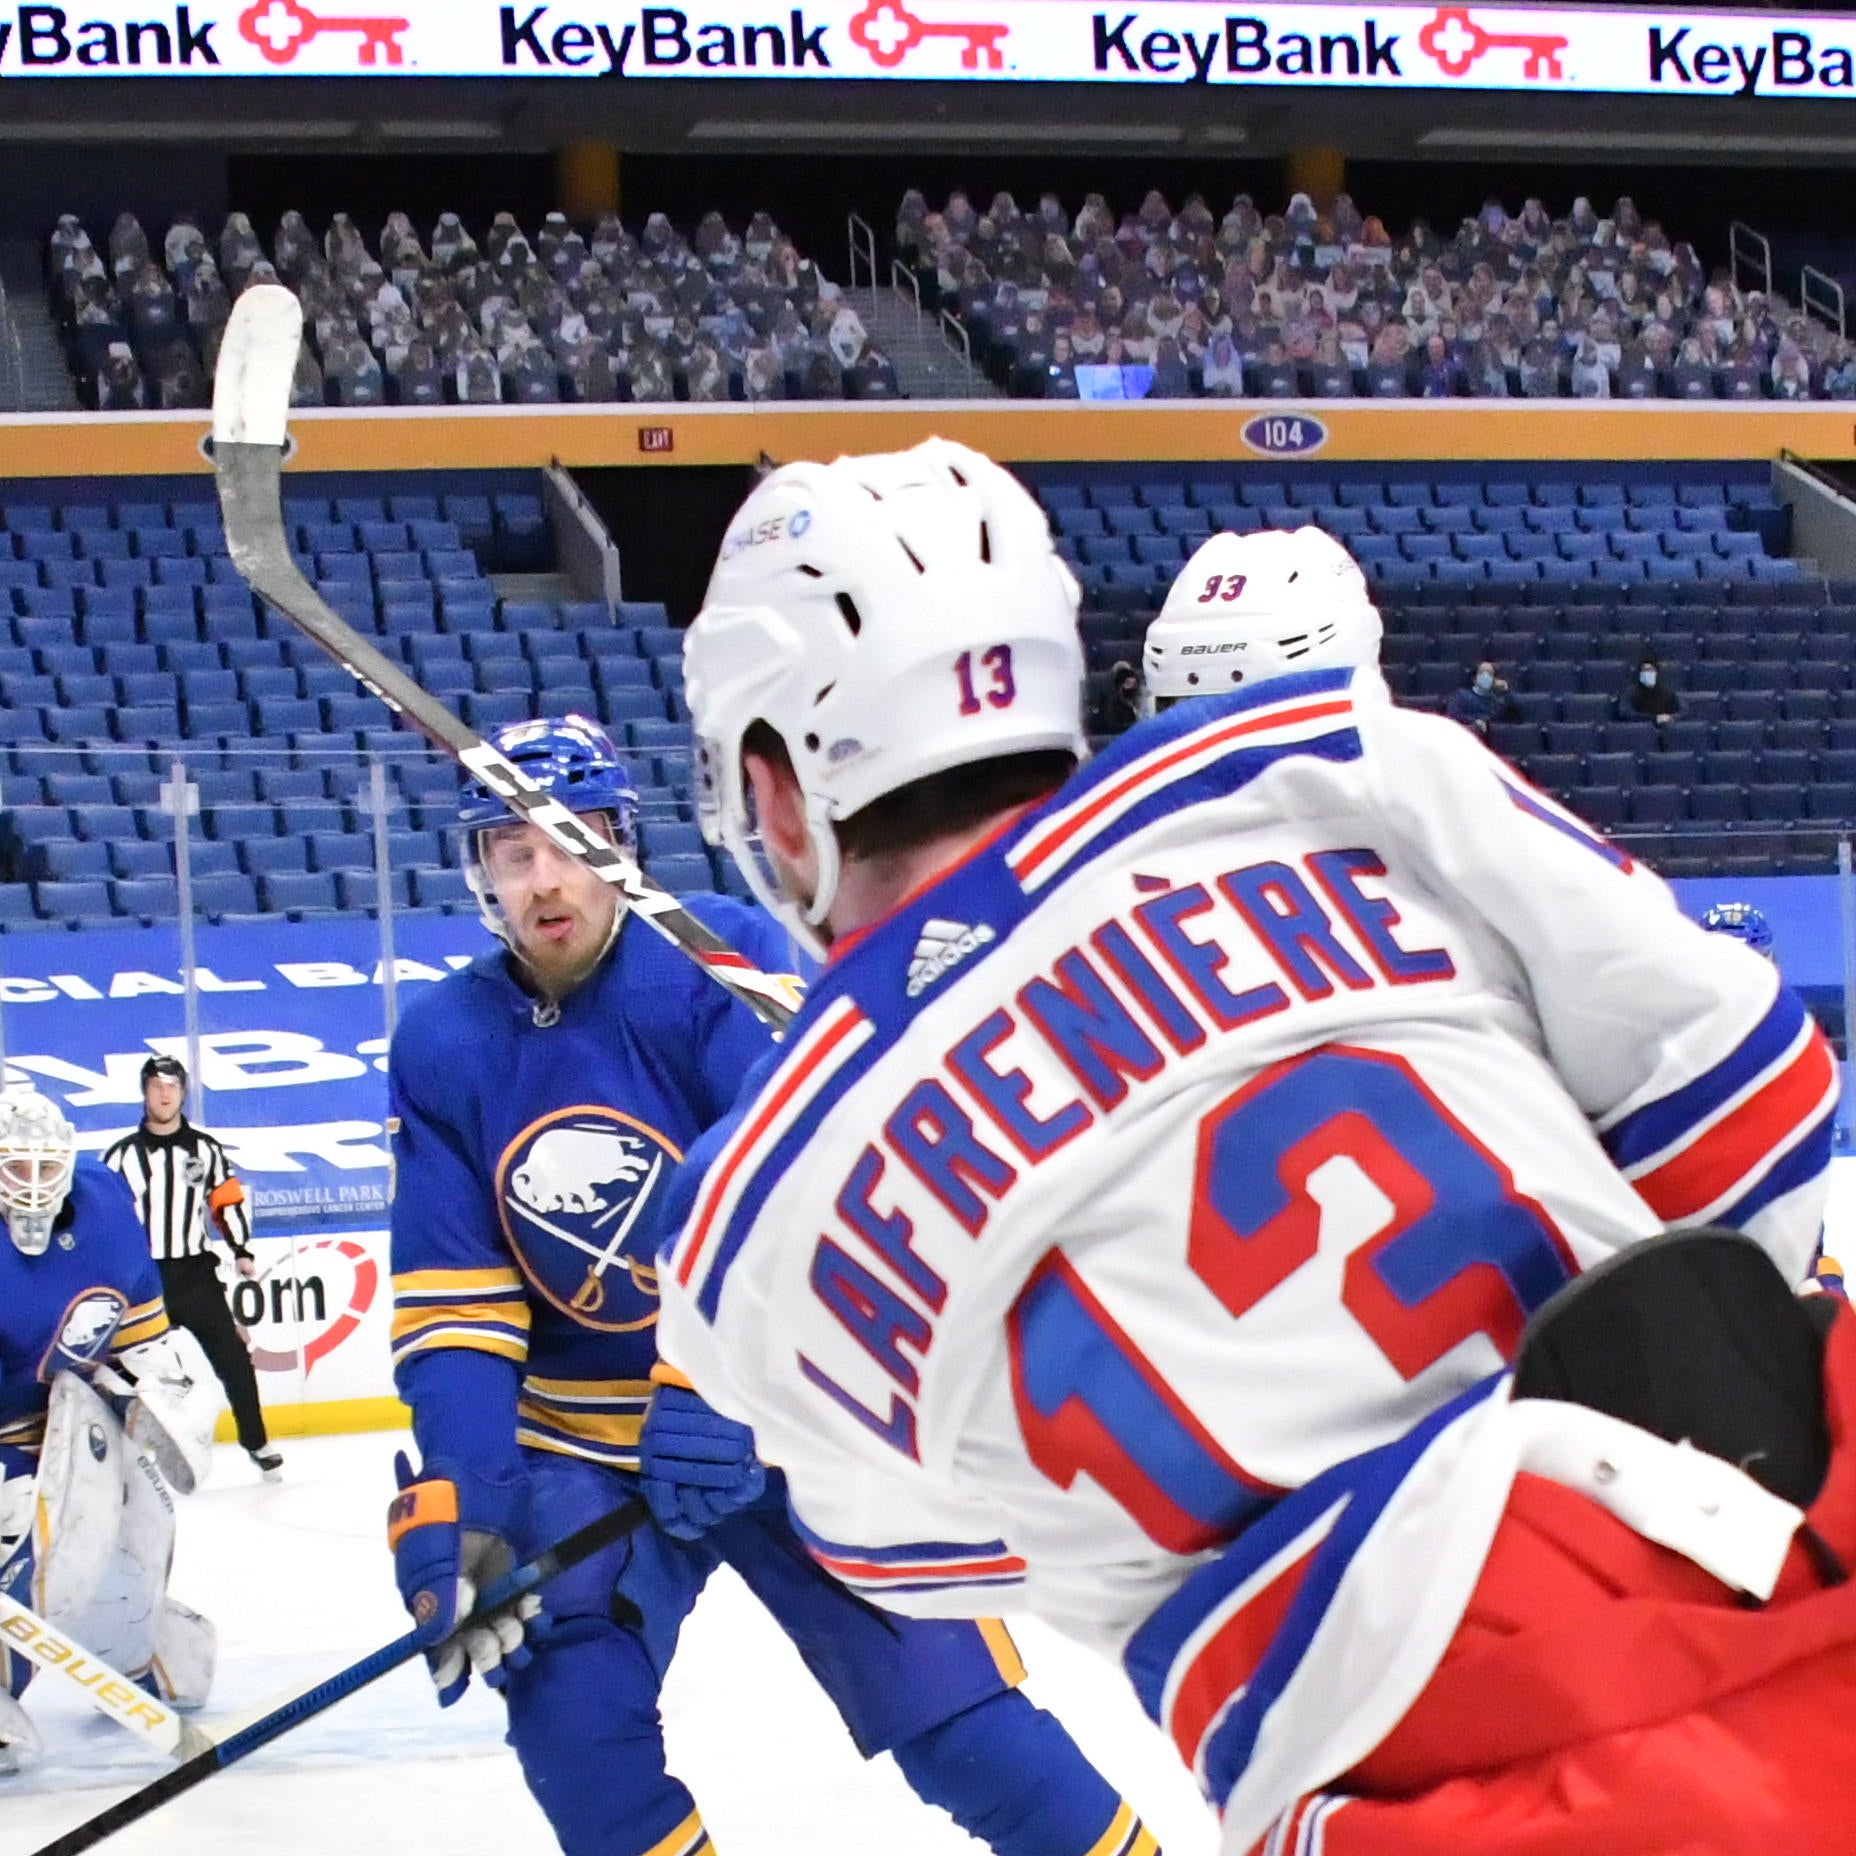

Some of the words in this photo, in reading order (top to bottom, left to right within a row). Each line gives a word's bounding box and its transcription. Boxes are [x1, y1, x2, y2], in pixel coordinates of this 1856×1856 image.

[501, 6, 832, 76] KeyBank
[1092, 14, 1402, 83] KeyBank
[1264, 419, 1303, 447] 104
[954, 644, 1016, 717] 13
[798, 847, 1457, 1467] LAFRENIÈRE
[254, 1187, 336, 1207] ROSWELL
[339, 1184, 385, 1202] PARK
[1007, 1041, 1578, 1556] 13
